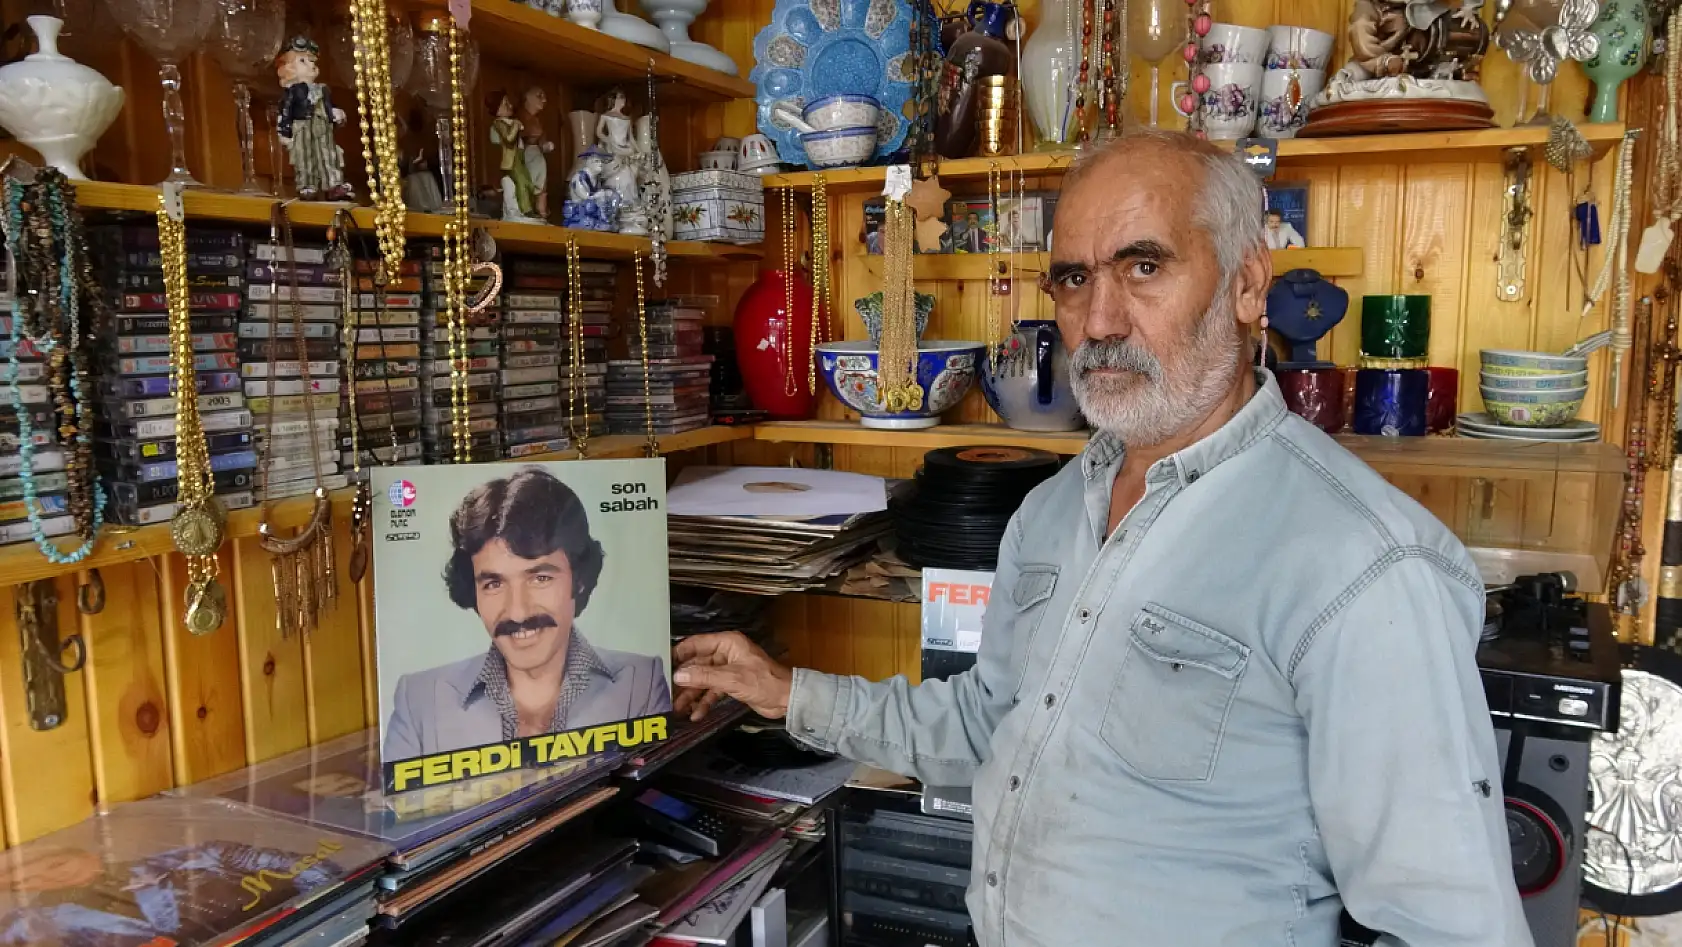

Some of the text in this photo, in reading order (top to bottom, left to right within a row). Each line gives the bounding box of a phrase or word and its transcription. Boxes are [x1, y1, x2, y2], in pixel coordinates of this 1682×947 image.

[611, 481, 646, 495] son
[599, 497, 659, 513] sabah
[529, 715, 668, 763] TAYFUR
